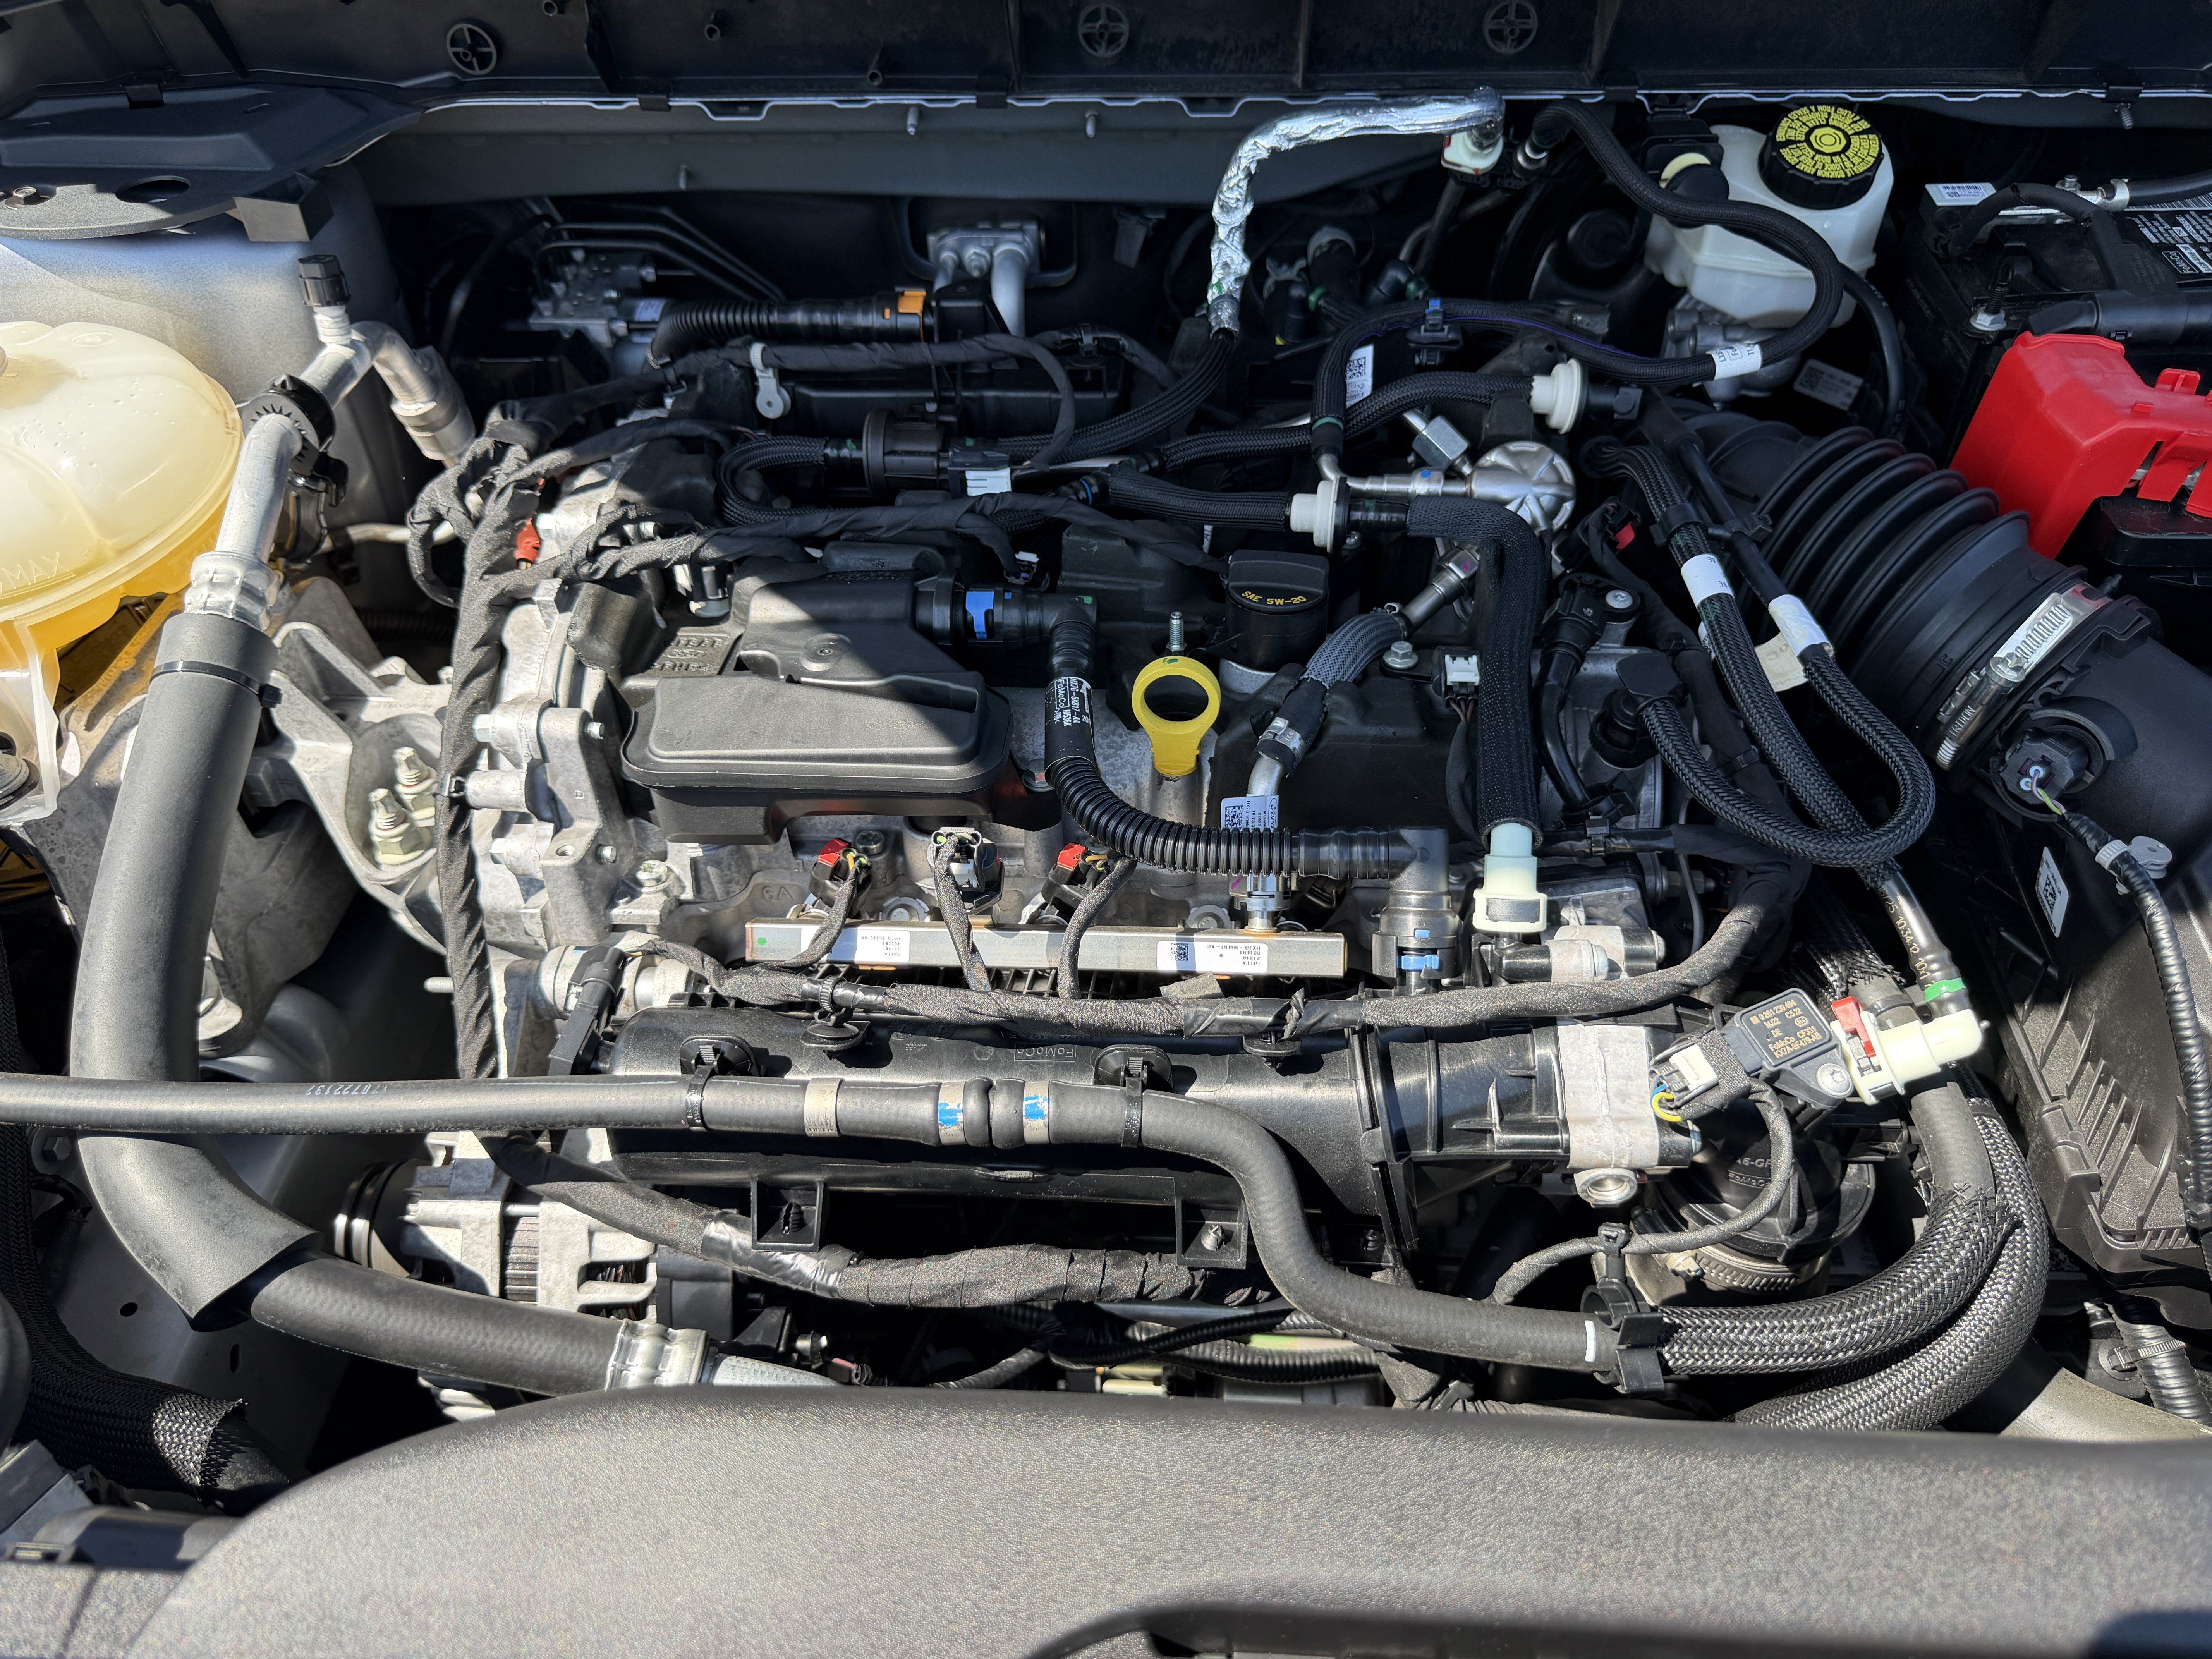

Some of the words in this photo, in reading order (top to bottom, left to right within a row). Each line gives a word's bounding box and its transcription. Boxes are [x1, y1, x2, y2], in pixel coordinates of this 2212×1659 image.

[2, 551, 70, 589] MAX
[1242, 591, 1262, 602] SAE
[1267, 596, 1306, 605] 5W-20
[1896, 916, 1920, 956] 10:34:12
[1763, 1009, 1776, 1018] 261
[1773, 1004, 1786, 1014] 230
[1768, 1037, 1796, 1051] FoMoCo
[1017, 1046, 1073, 1058] FoMoCo
